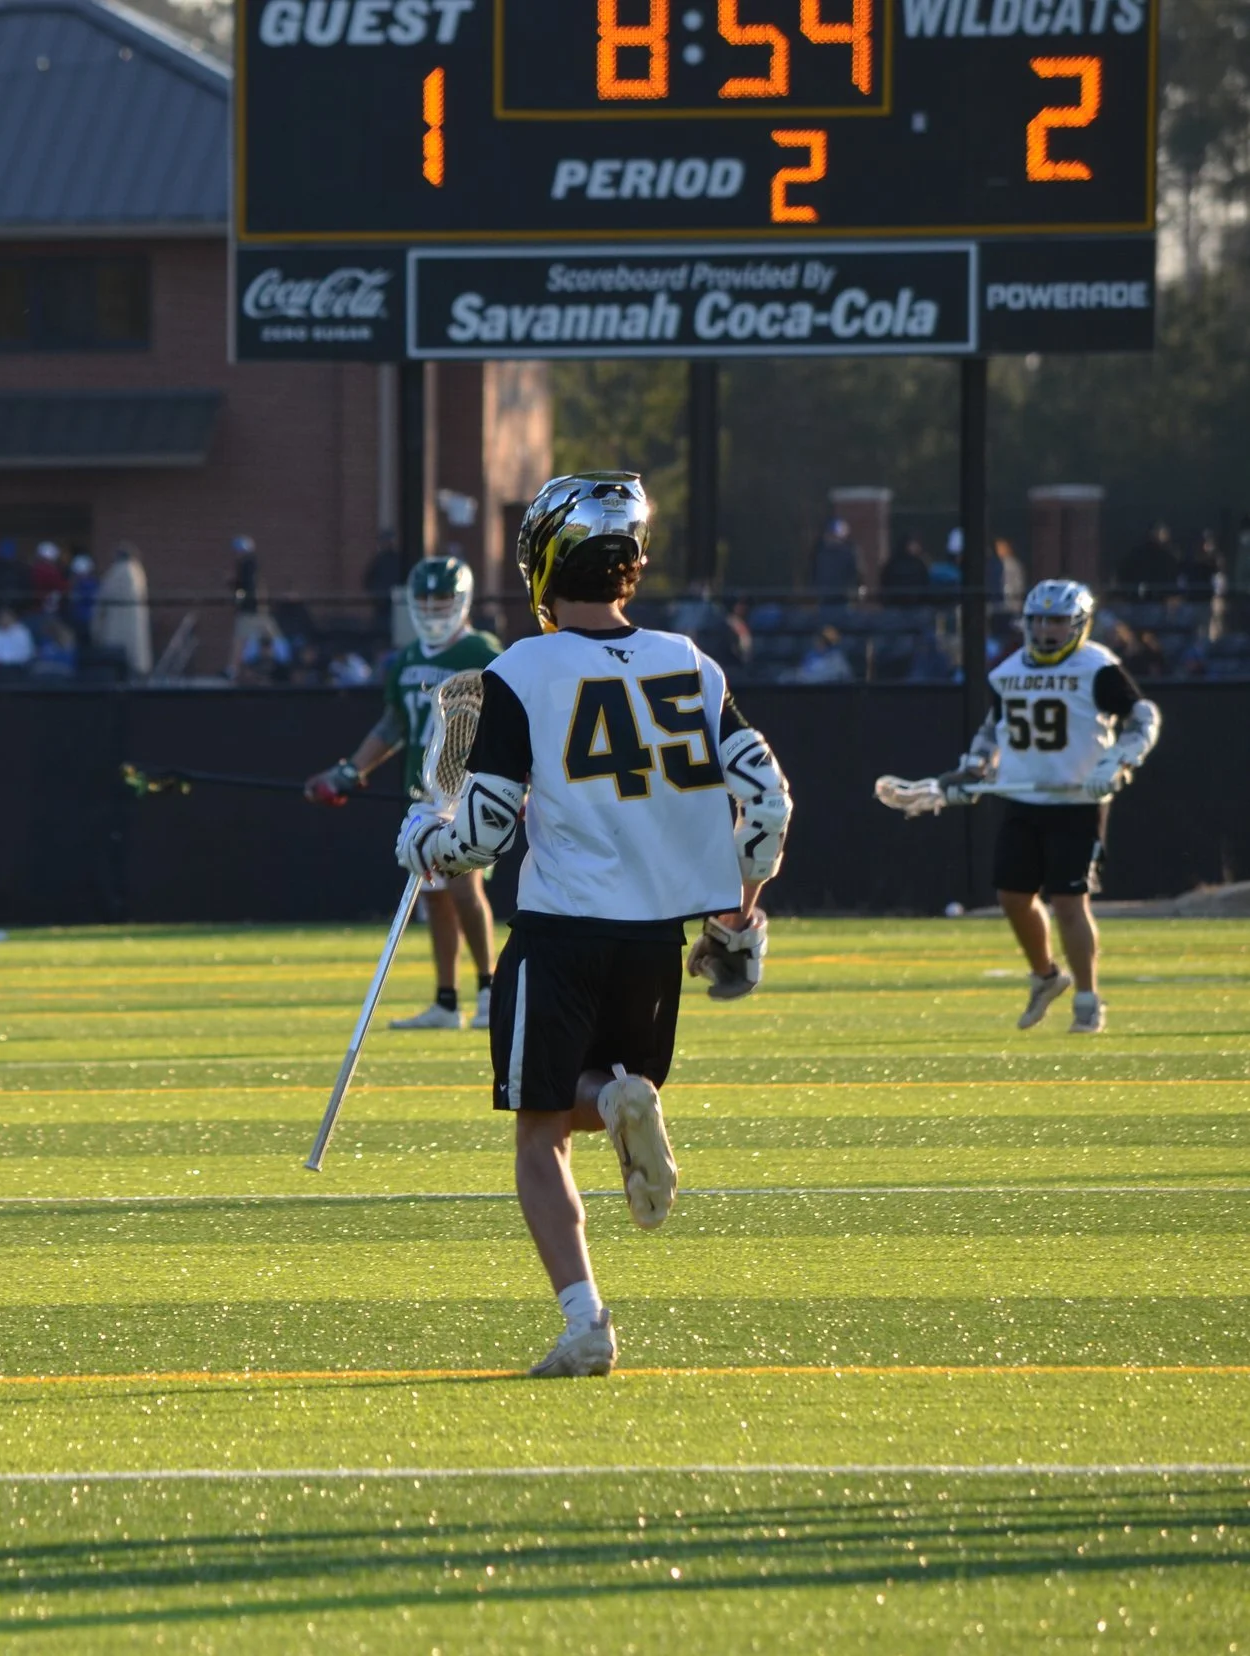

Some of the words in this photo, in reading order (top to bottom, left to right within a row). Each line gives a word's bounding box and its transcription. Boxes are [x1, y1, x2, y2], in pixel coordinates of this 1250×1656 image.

[259, 0, 473, 46] GUEST
[902, 0, 1144, 38] WILDCATS
[597, 0, 872, 98] 8:54
[423, 67, 444, 187] 1
[1027, 56, 1102, 181] 2
[551, 159, 745, 199] PERIOD
[771, 130, 827, 222] 2
[547, 262, 690, 292] Scoreboard
[690, 262, 800, 290] Provided
[803, 260, 837, 294] By
[987, 281, 1148, 310] POWERADE
[447, 291, 681, 342] Savannah
[694, 287, 939, 340] Coca-Cola
[562, 670, 725, 801] 45
[1006, 697, 1068, 753] 59
